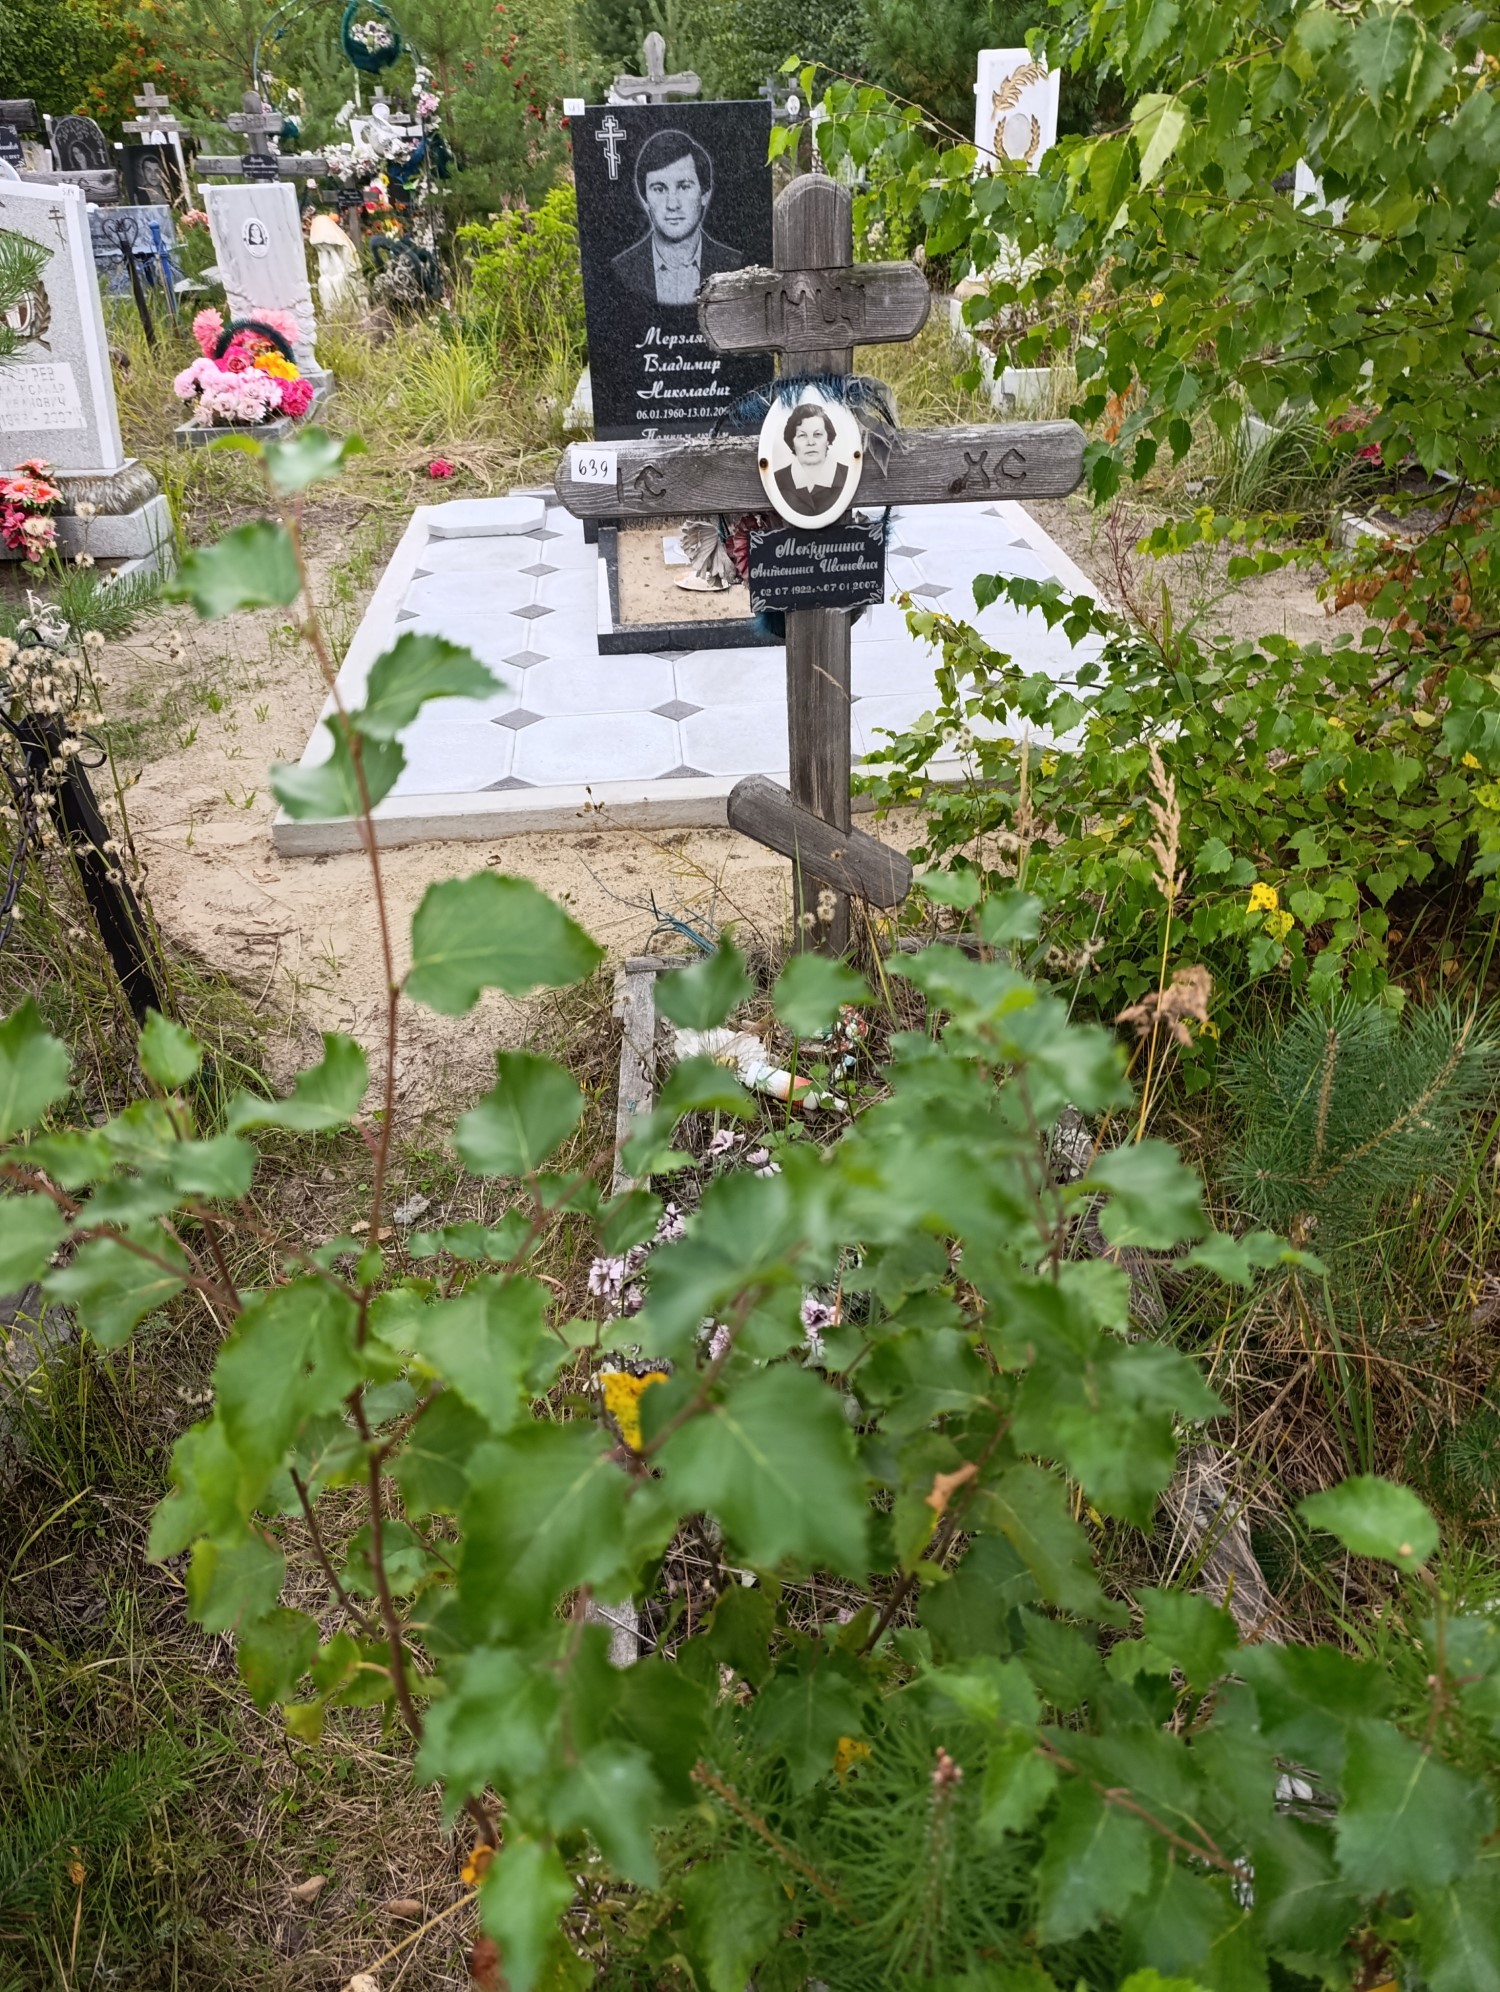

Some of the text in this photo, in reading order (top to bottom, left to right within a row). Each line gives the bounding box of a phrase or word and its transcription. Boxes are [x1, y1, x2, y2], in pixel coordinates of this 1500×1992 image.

[635, 326, 706, 350] Мерзля
[643, 353, 721, 374] Владимир
[636, 380, 731, 399] Николаевич
[636, 406, 730, 420] 06.01.1960-13.01.20
[578, 458, 608, 478] 639
[775, 538, 866, 560] Мокрушина
[750, 554, 879, 579] Антонина Ивановна
